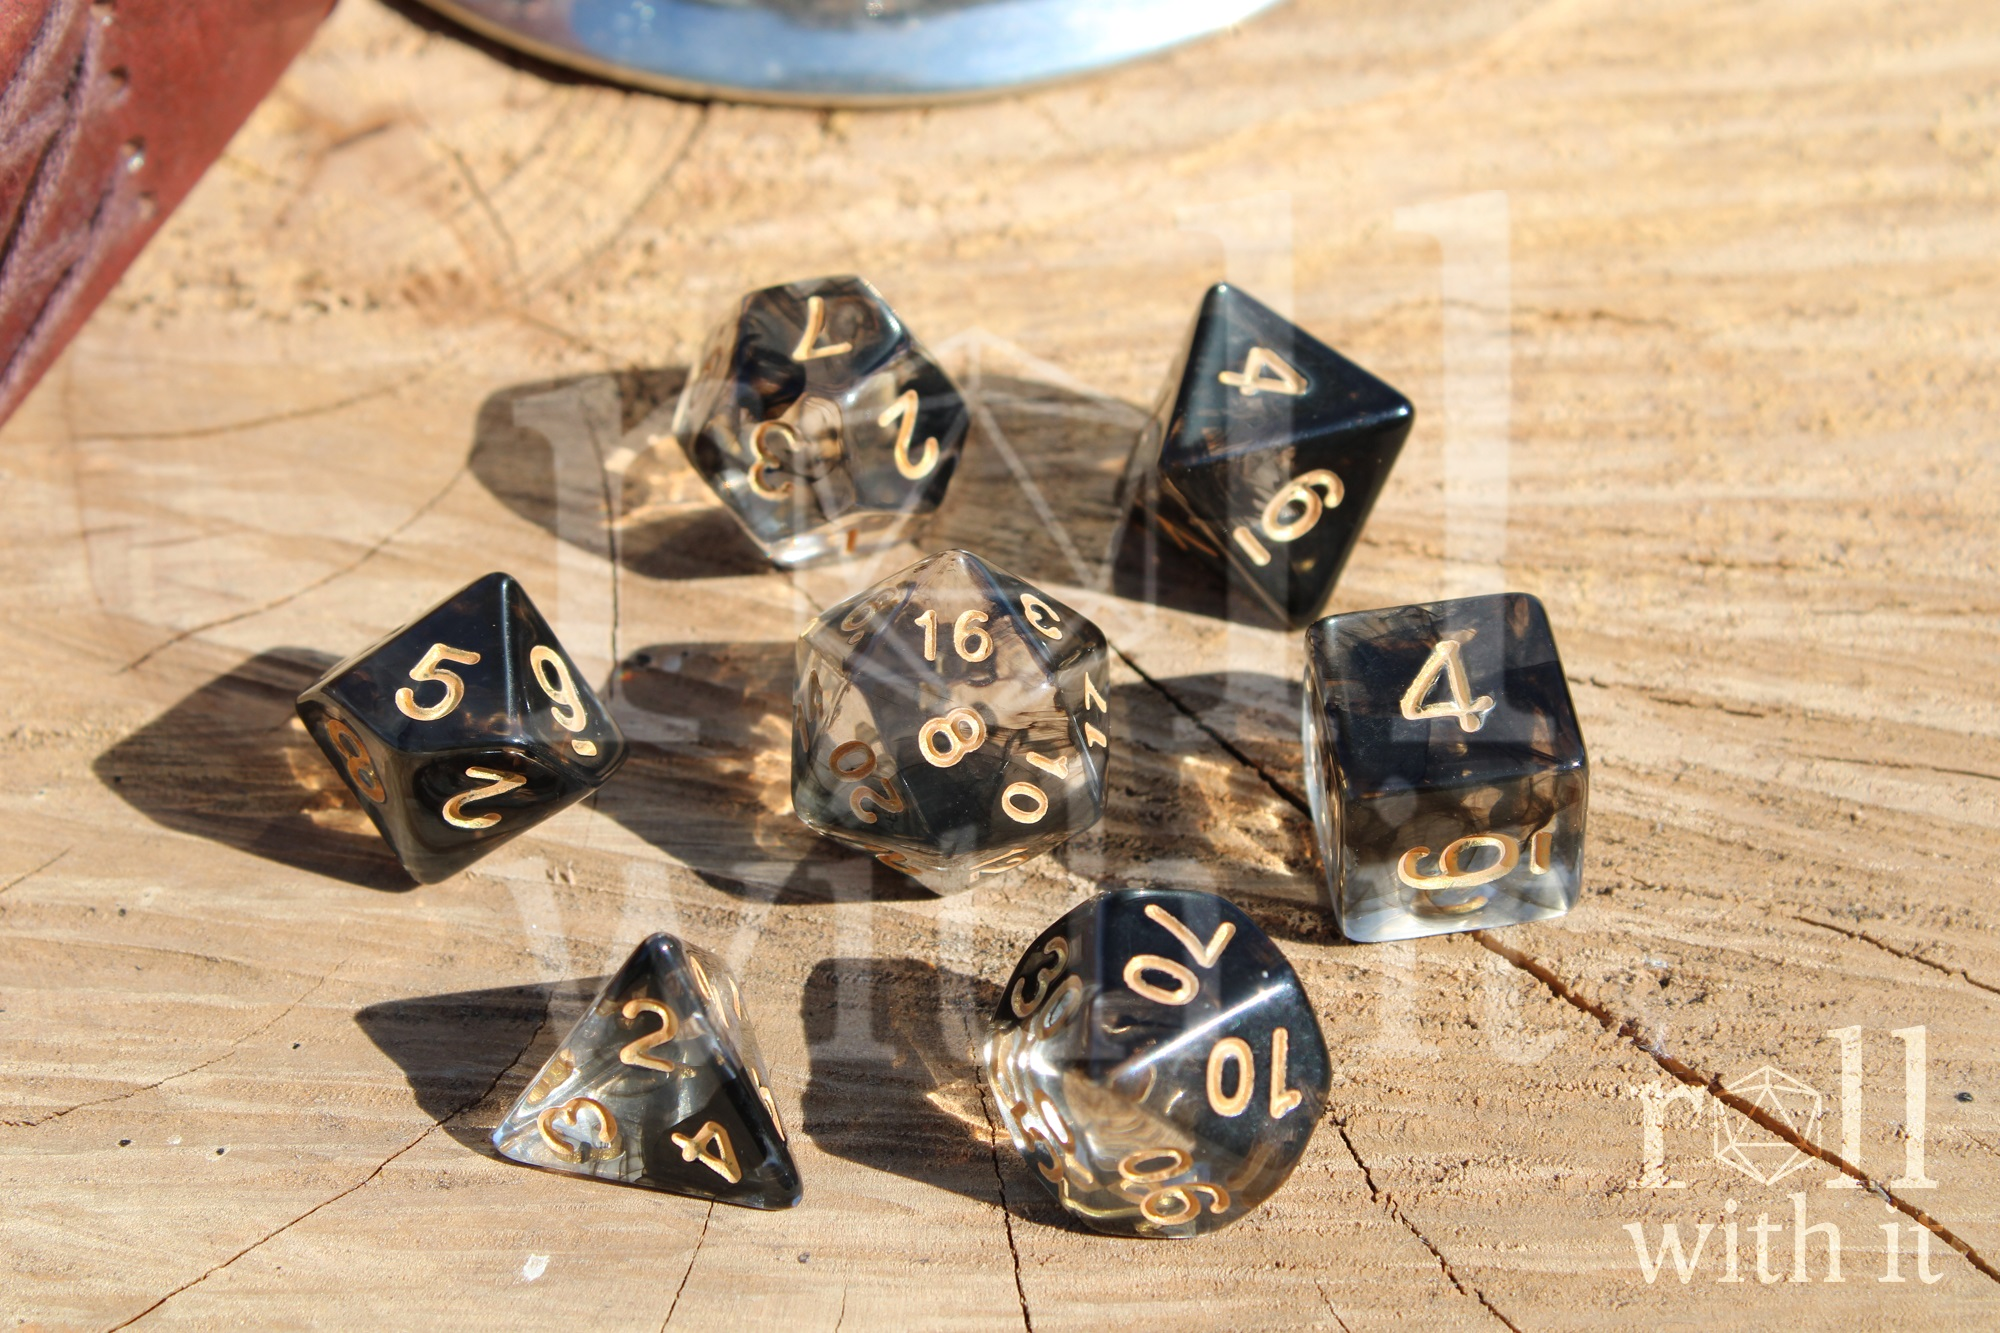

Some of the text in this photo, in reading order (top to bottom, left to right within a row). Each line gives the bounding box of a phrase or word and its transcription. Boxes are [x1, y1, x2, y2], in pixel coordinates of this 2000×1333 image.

[793, 296, 852, 361] 7
[1219, 347, 1308, 396] 4
[879, 390, 939, 480] 2
[914, 609, 993, 663] 16
[1020, 593, 1062, 640] 3
[395, 643, 481, 722] 5
[1401, 640, 1494, 733] 4
[918, 707, 986, 768] 8
[443, 766, 527, 829] 2
[829, 740, 904, 824] 20
[1001, 751, 1068, 824] 10
[1123, 904, 1236, 1006] 70
[620, 998, 679, 1073] 2
[1206, 1027, 1302, 1119] 10
[537, 1096, 618, 1155] 3
[671, 1121, 742, 1184] 4
